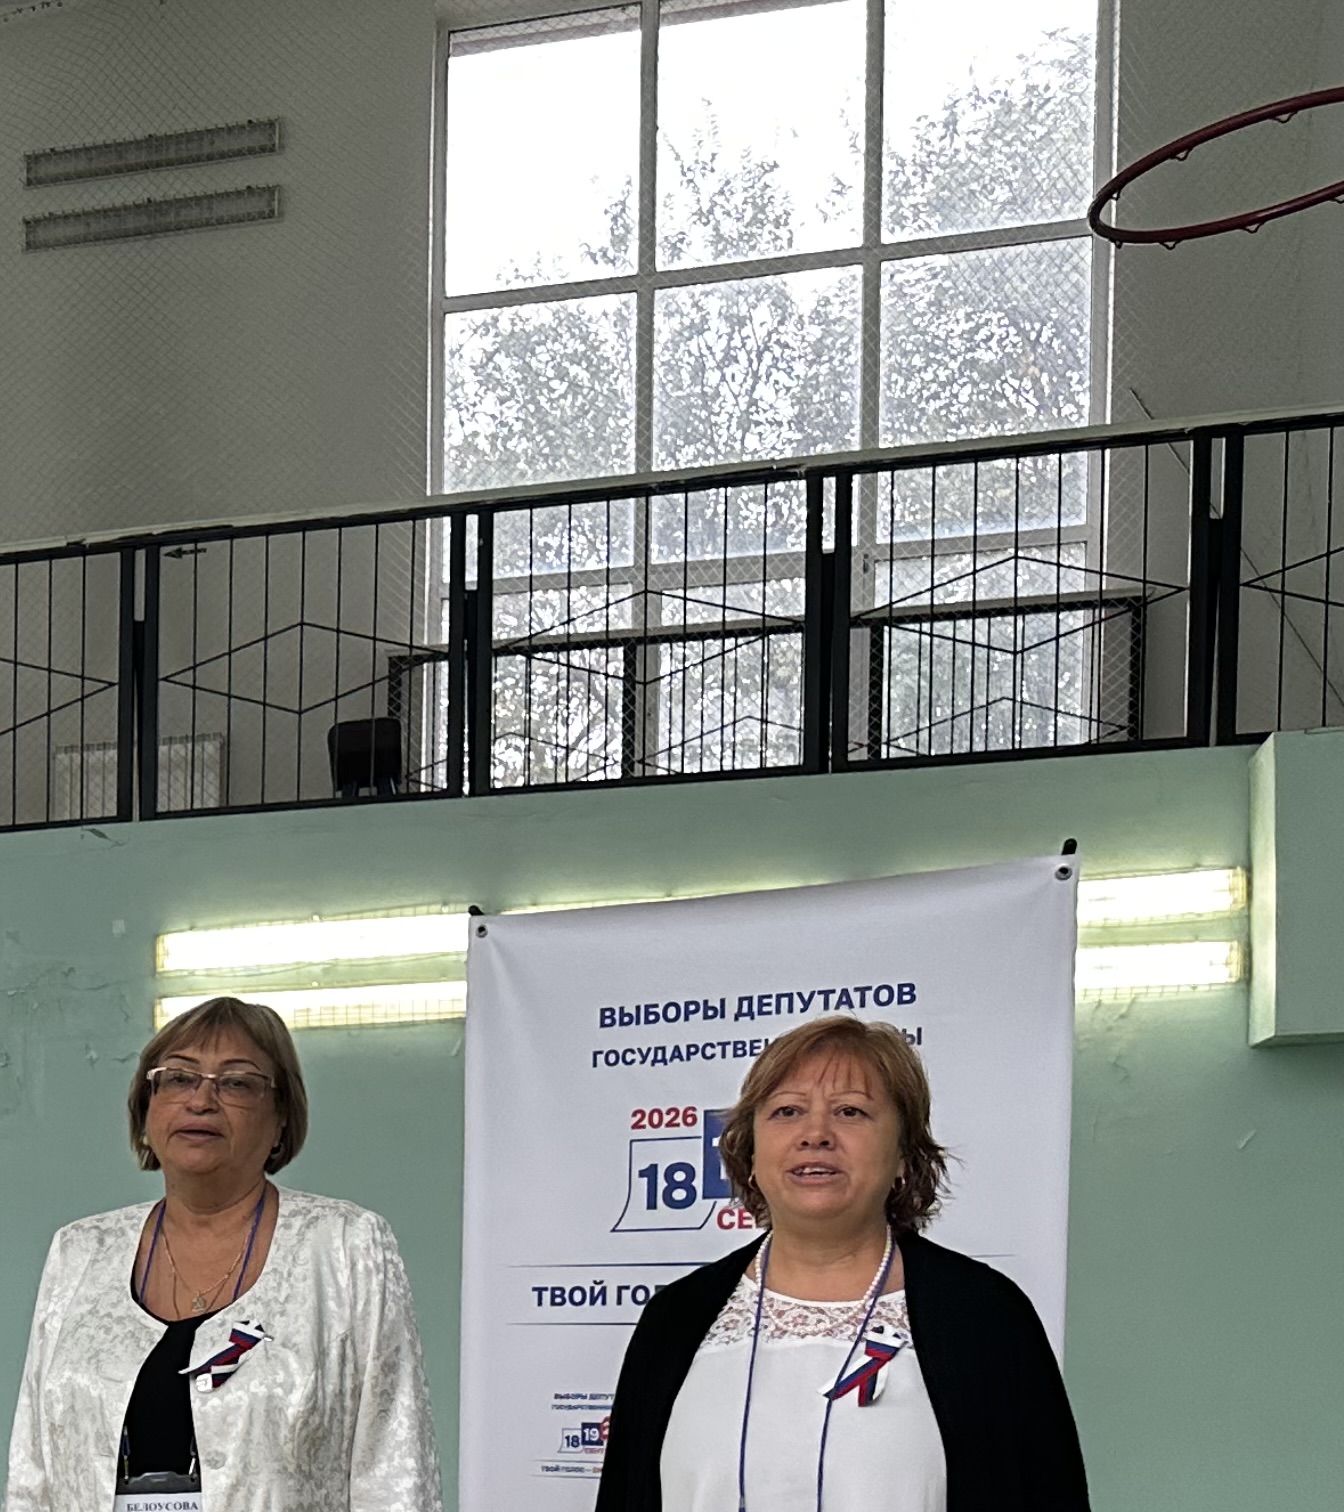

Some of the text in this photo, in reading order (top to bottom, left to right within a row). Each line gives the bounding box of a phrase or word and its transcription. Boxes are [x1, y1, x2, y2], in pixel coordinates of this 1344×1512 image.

[599, 982, 917, 1029] ВЫБОРЫ ДЕПУТАТОВ
[630, 1106, 699, 1131] 2026
[638, 1161, 698, 1212] 18
[531, 1280, 607, 1307] ТВОЙ
[564, 1434, 581, 1448] 18
[583, 1428, 600, 1442] 19
[126, 1501, 199, 1512] БЕЛОУСОВА
